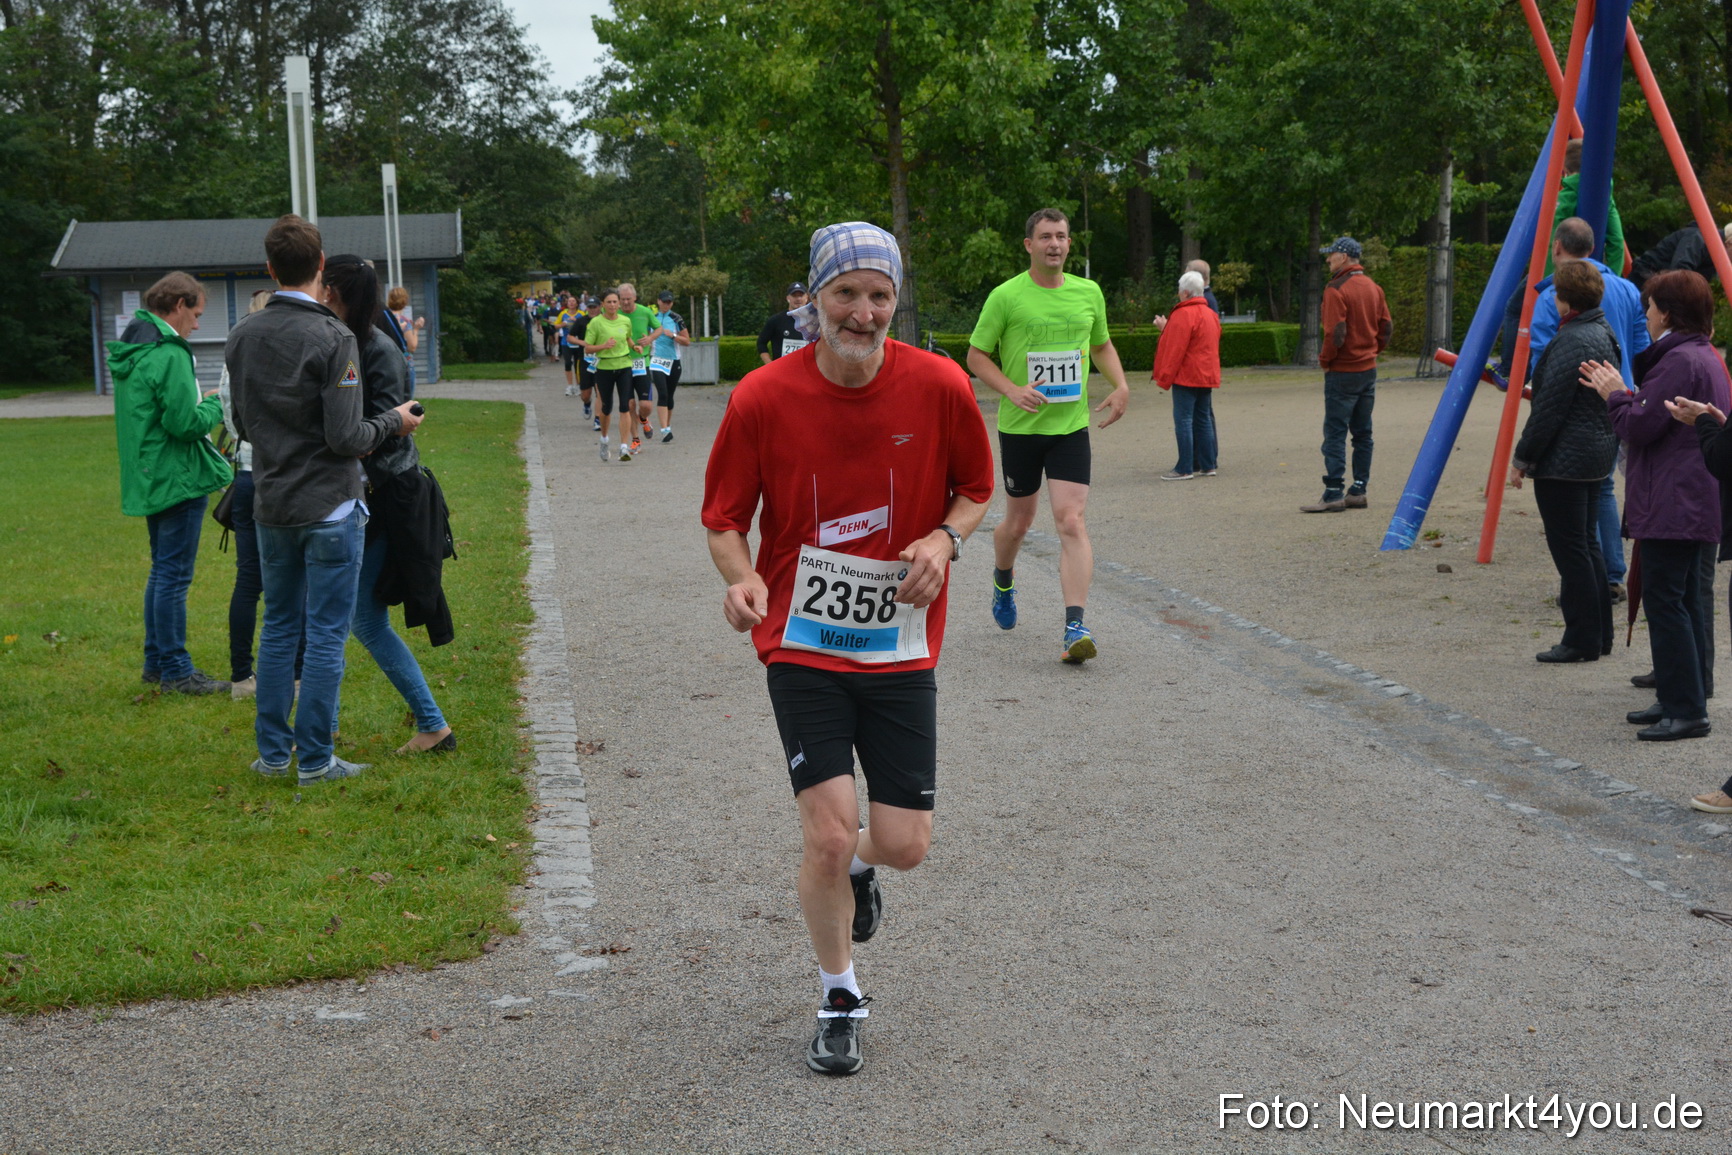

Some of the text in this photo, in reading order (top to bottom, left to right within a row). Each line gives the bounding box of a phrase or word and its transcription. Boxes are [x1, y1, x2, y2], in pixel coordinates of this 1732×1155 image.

[1034, 363, 1076, 383] 2111
[838, 519, 869, 535] DEHN
[800, 555, 895, 581] PARTL Neumarkt
[802, 576, 897, 623] 2358
[820, 628, 870, 648] Walter
